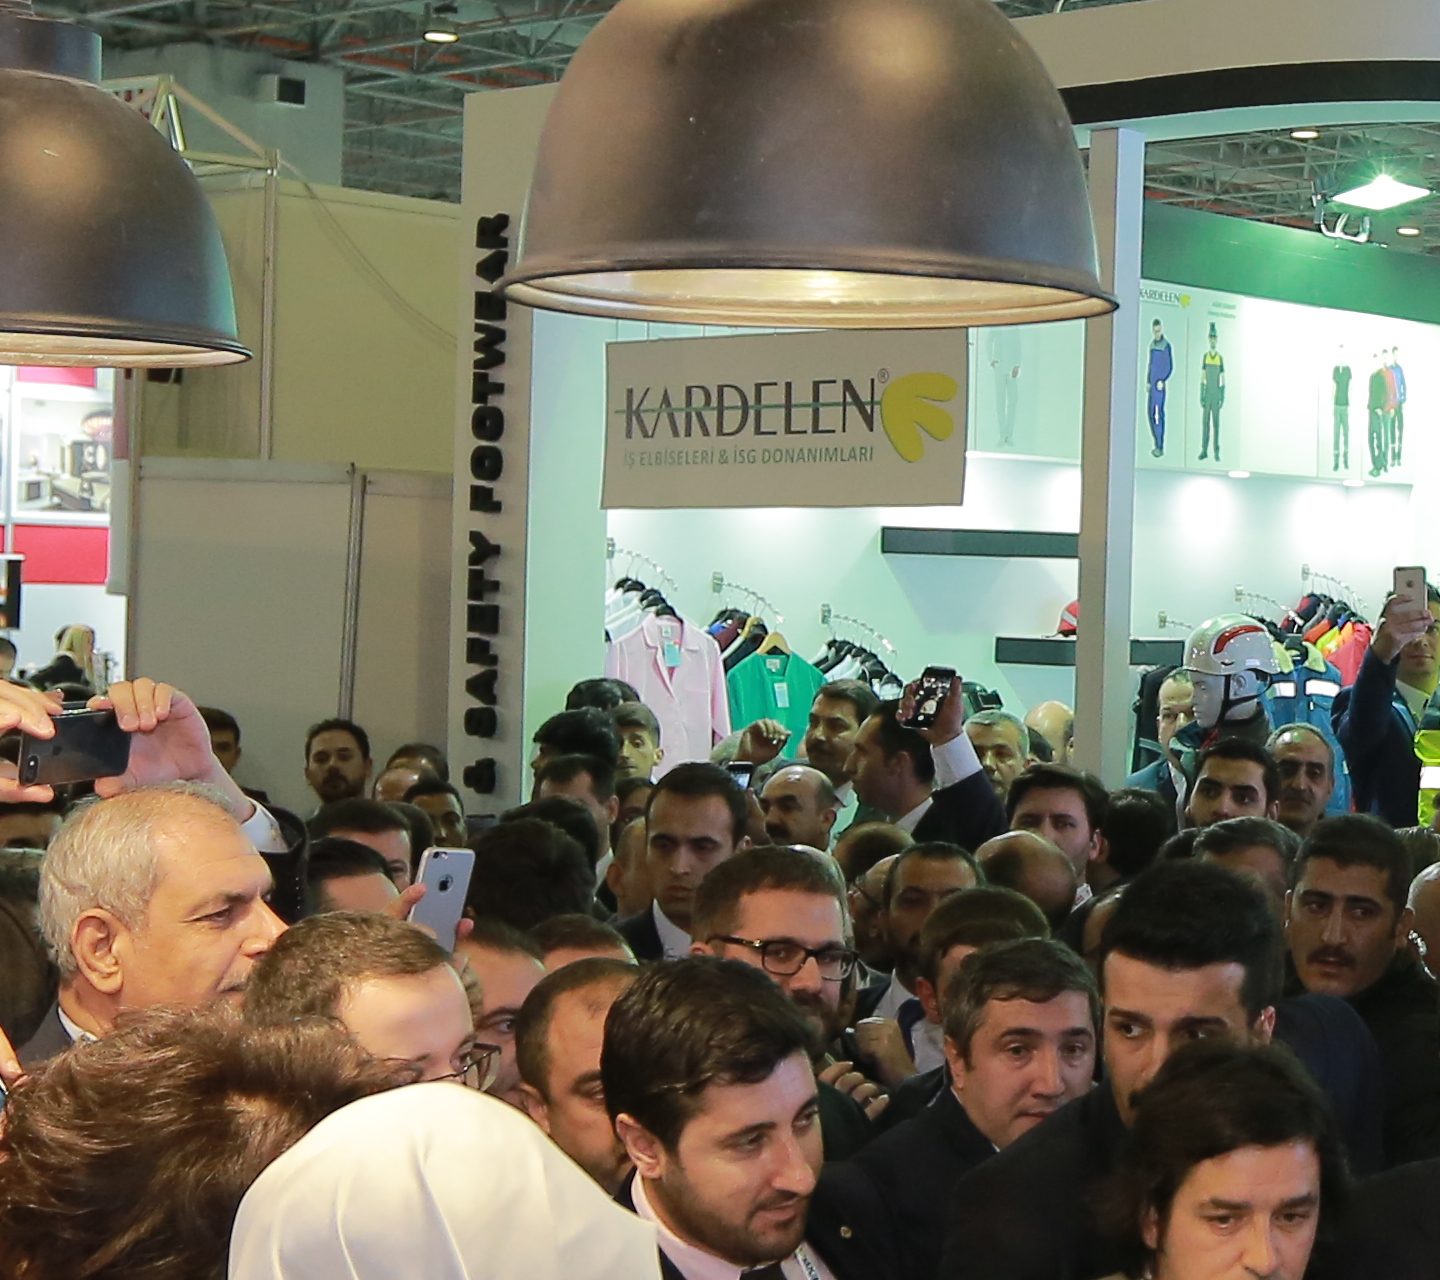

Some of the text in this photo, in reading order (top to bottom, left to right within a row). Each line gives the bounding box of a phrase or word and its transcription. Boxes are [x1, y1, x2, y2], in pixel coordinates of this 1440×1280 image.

[469, 211, 512, 514] FOOTWEAR
[624, 377, 876, 440] KARDELEN
[639, 446, 715, 467] ELBİSELERİ
[718, 448, 729, 465] &
[732, 443, 757, 465] İSG
[761, 445, 875, 465] DONANIMLARI
[463, 529, 502, 739] SAFETY
